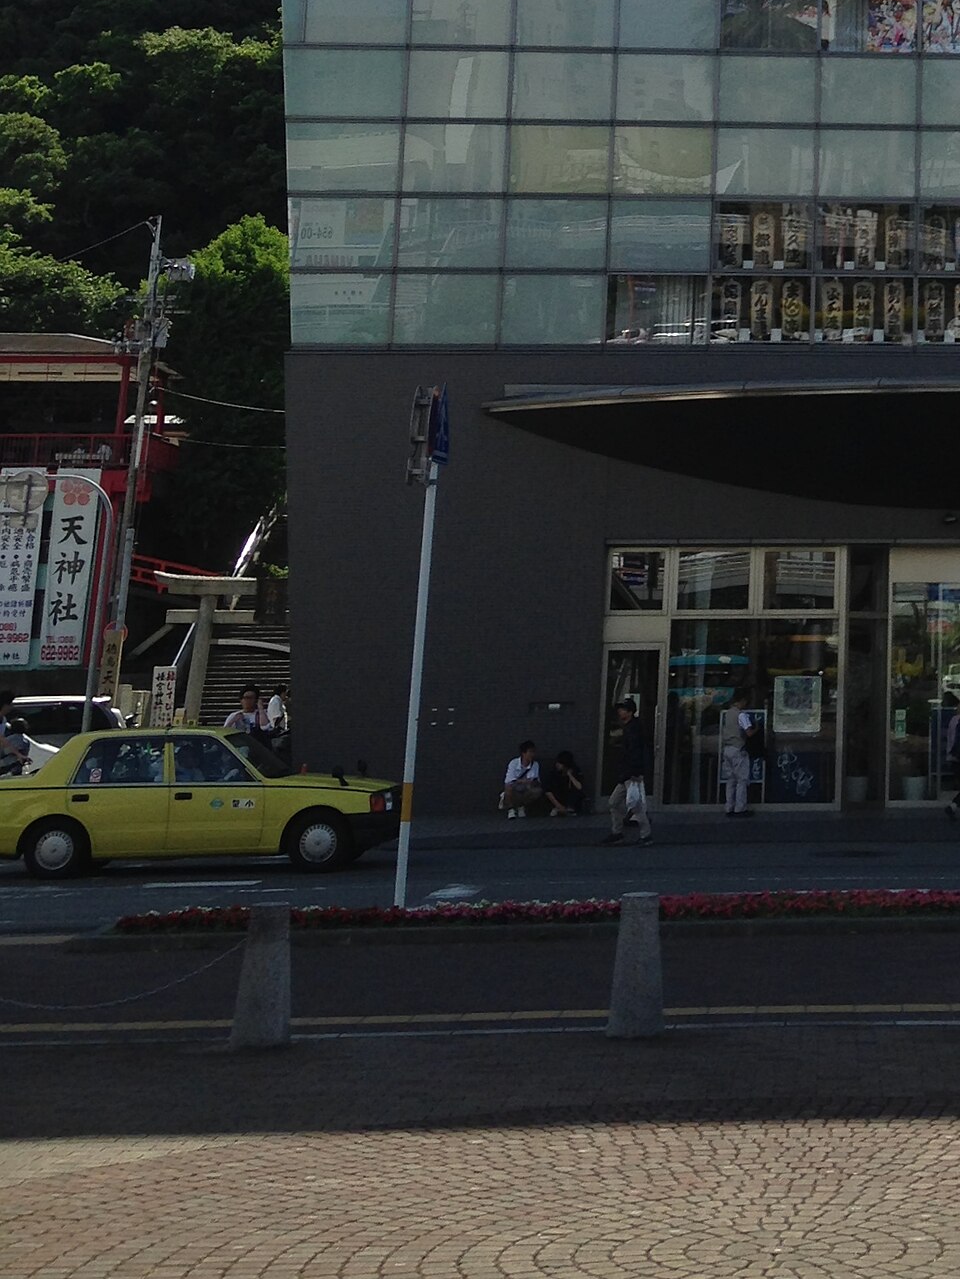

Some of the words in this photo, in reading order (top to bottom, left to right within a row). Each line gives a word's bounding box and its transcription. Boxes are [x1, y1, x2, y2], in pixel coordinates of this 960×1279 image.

[48, 516, 88, 627] 天神社
[41, 645, 80, 661] 622-9962
